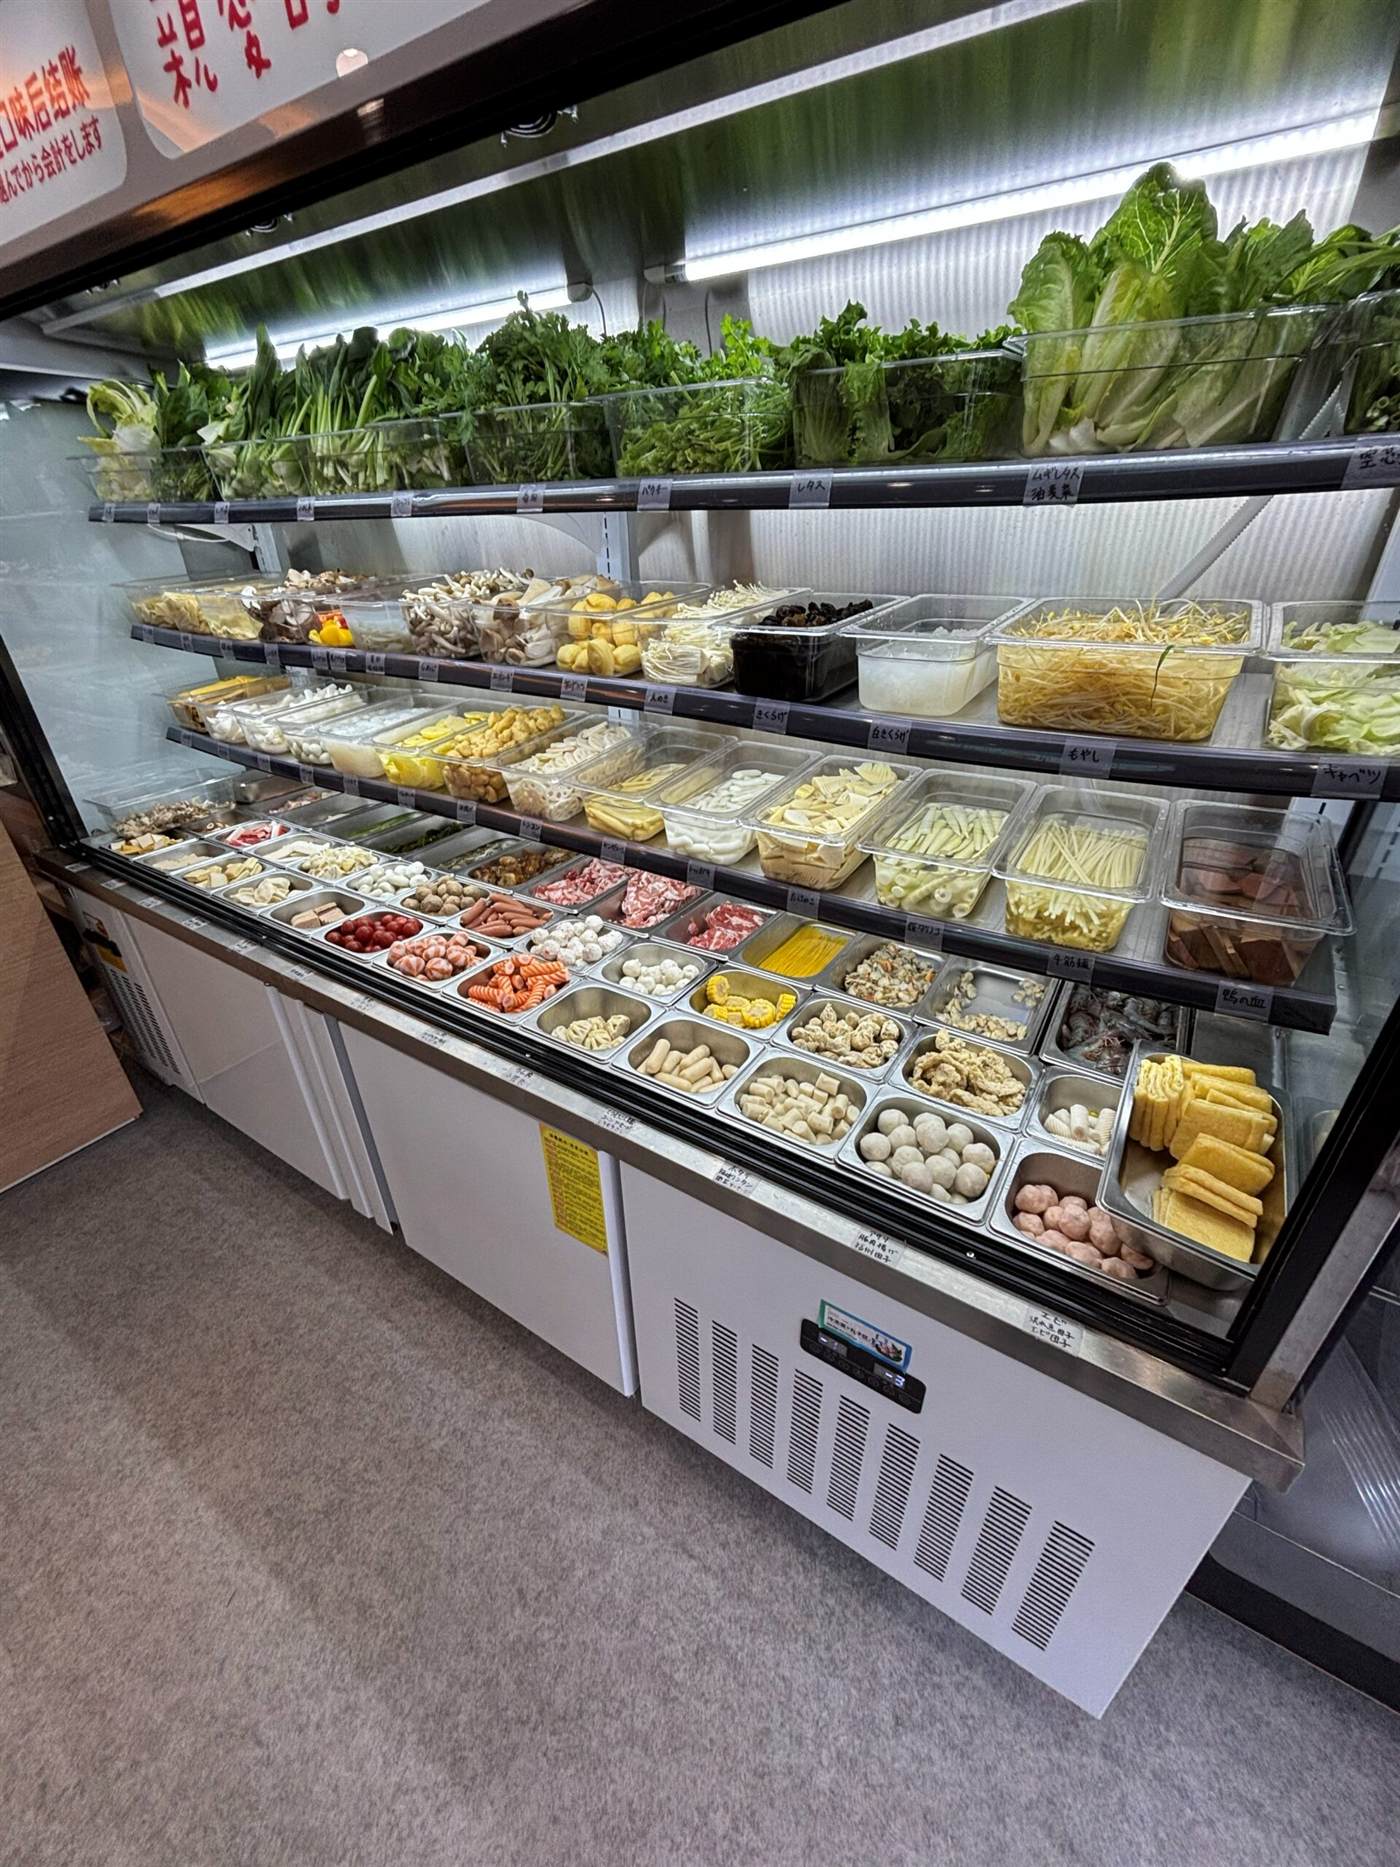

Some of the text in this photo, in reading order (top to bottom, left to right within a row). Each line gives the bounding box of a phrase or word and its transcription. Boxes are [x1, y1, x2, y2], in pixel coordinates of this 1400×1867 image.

[0, 45, 90, 159] 口味后结账
[755, 709, 788, 724] きくらげ
[871, 726, 910, 743] 白きくらげ
[1067, 748, 1101, 763] もやし
[1322, 765, 1382, 785] キャベツ
